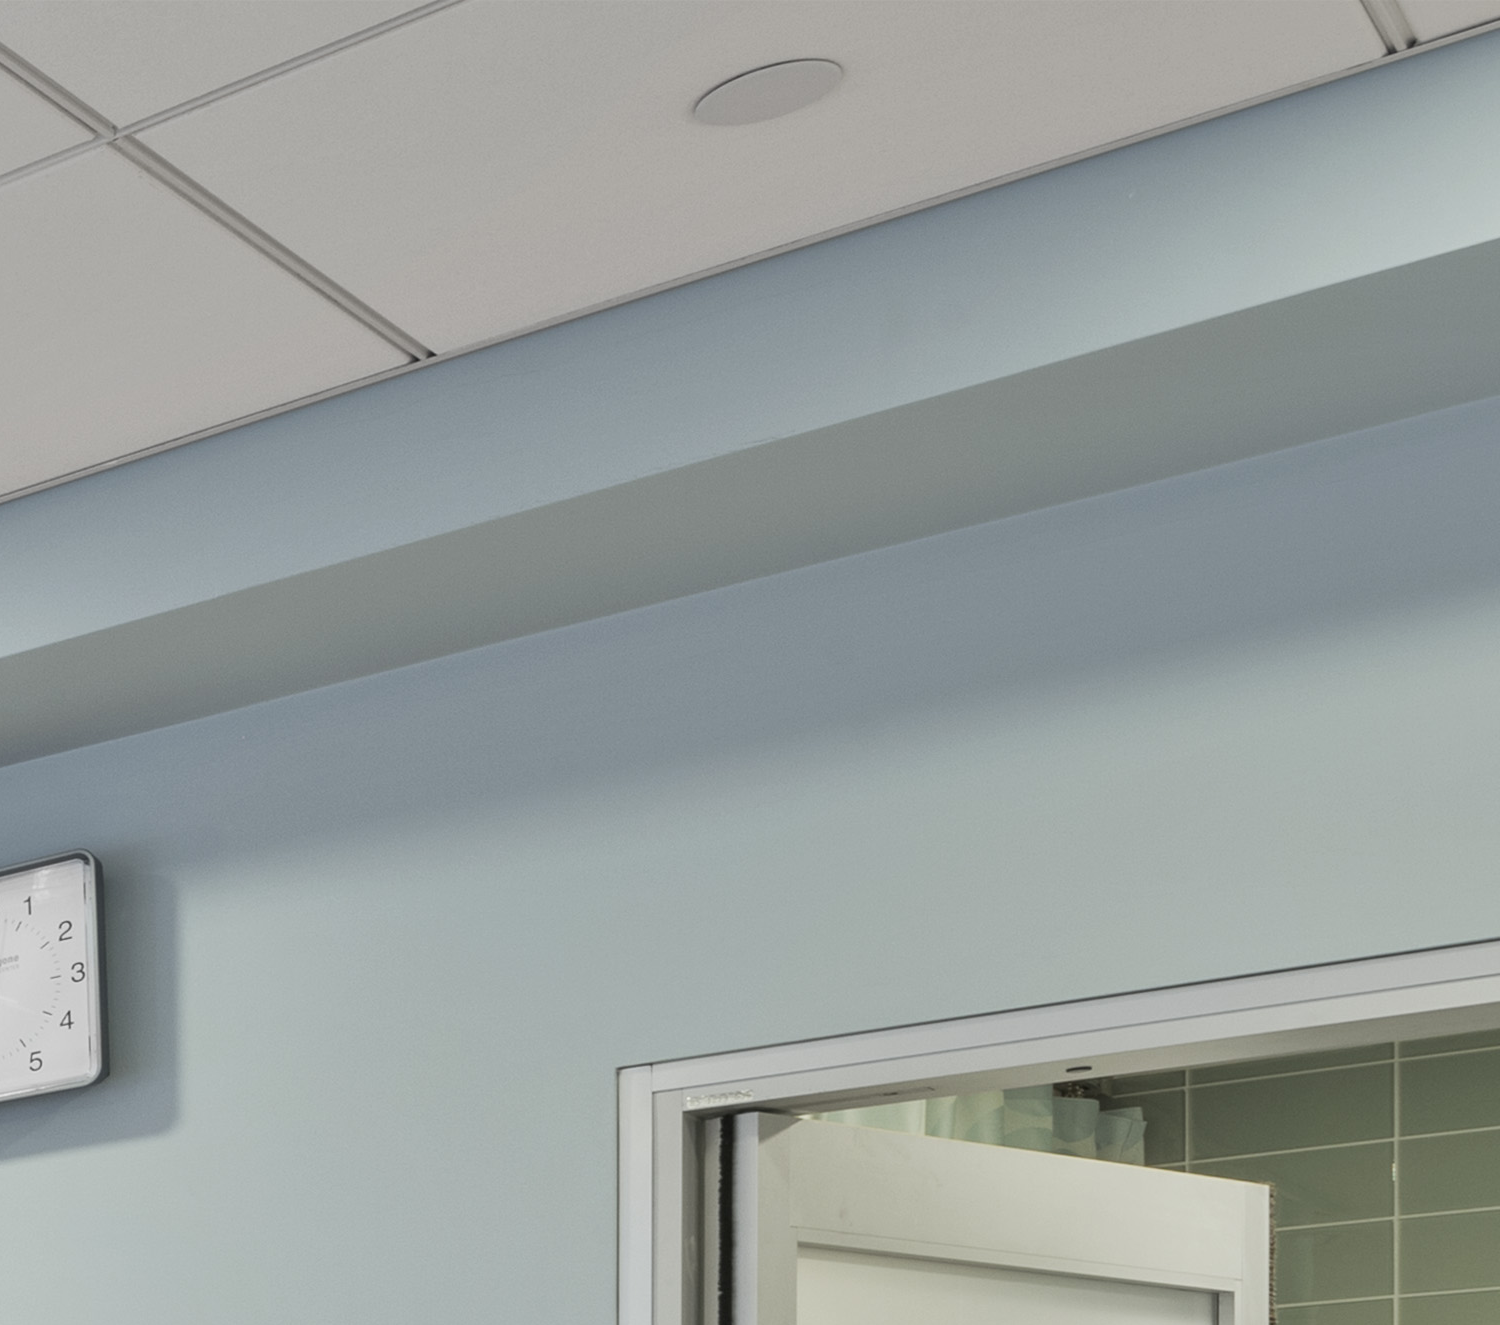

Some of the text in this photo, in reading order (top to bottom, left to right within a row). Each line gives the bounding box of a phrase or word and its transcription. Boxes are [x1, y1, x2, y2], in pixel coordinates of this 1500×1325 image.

[23, 896, 33, 915] 1
[58, 920, 73, 942] 2
[70, 962, 86, 983] 3
[59, 1010, 75, 1030] 4
[29, 1051, 43, 1072] 5
